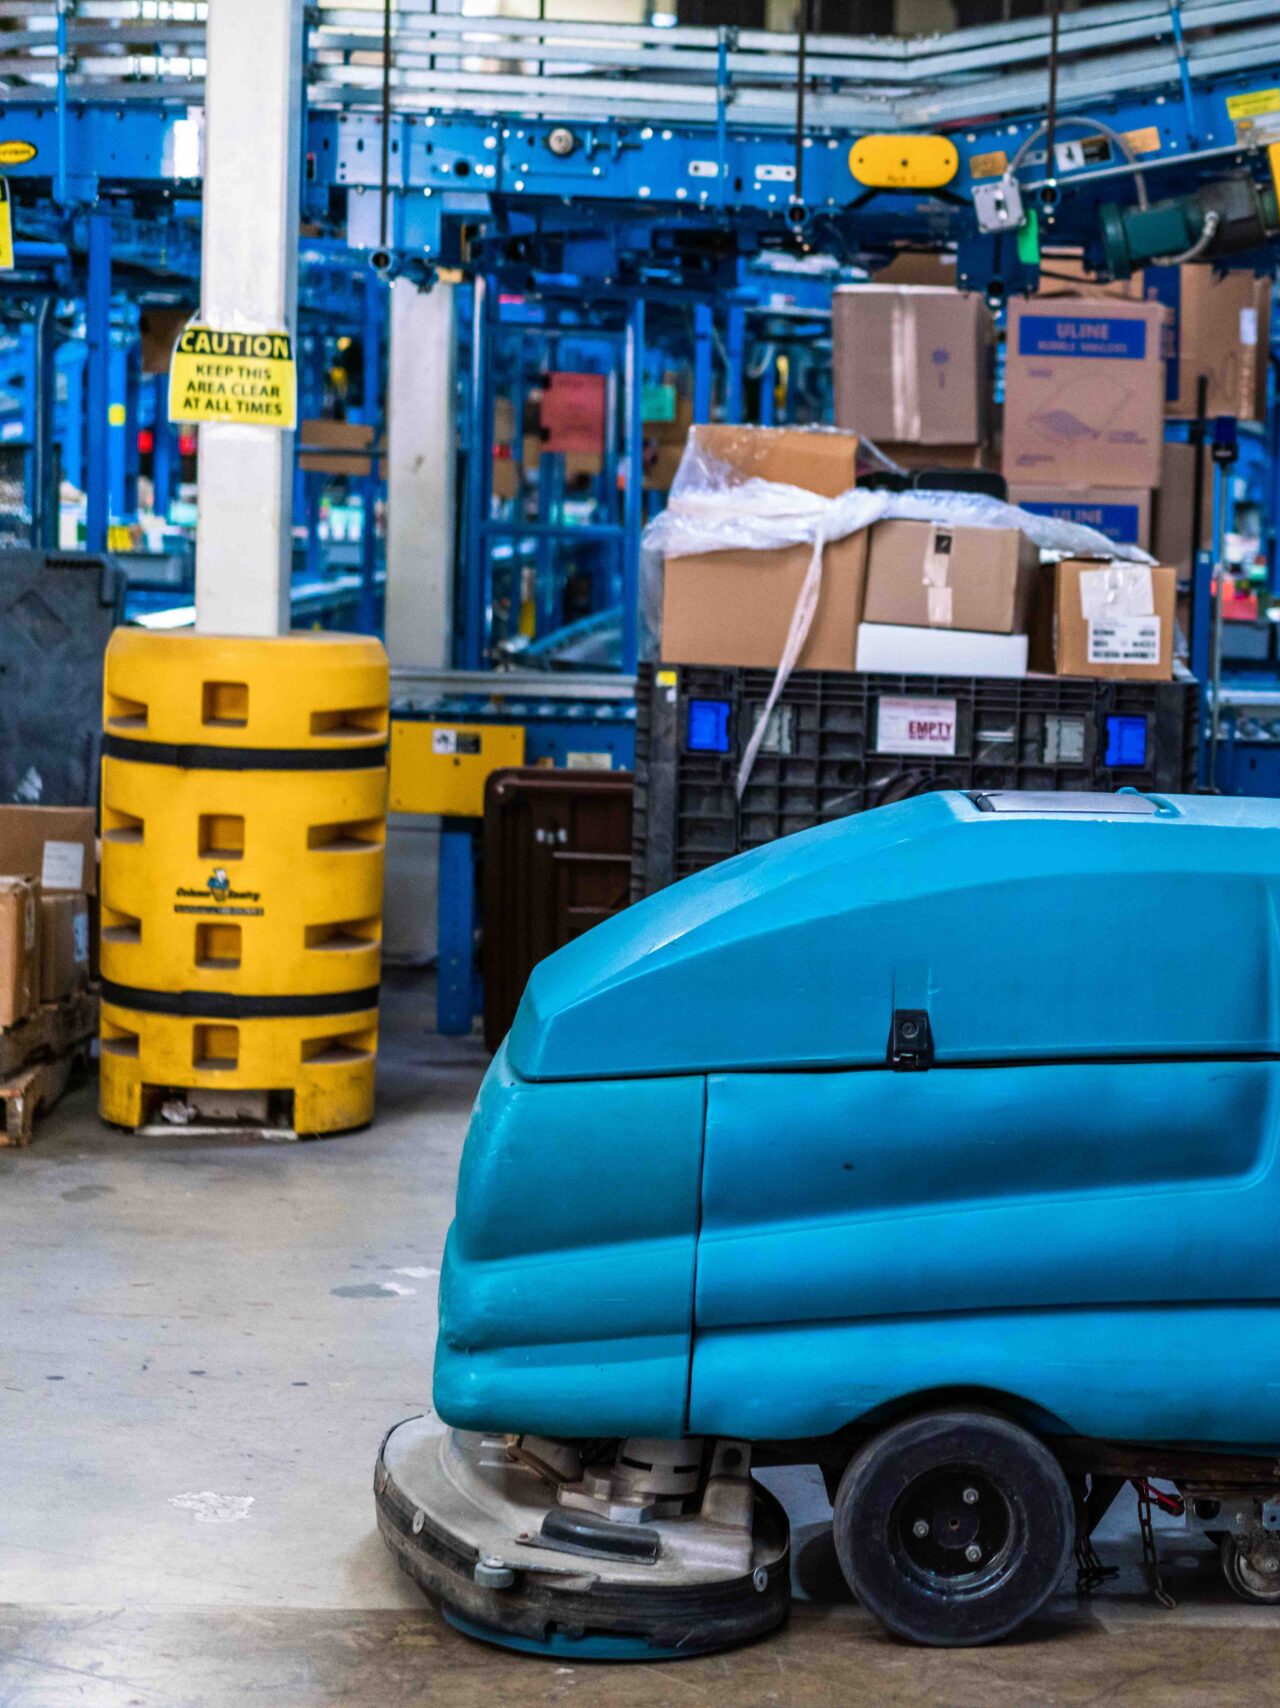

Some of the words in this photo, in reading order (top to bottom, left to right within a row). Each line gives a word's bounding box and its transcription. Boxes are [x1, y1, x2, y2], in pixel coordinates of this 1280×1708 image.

[1056, 322, 1109, 340] ULINE
[180, 330, 290, 359] CAUTION
[195, 364, 234, 376] KEEP
[237, 366, 272, 381] THIS
[186, 380, 227, 396] AREA
[230, 383, 280, 398] CLEAR
[183, 396, 200, 411] AT
[204, 398, 232, 413] ALL
[236, 400, 283, 416] TIMES
[908, 720, 953, 735] EMPTY
